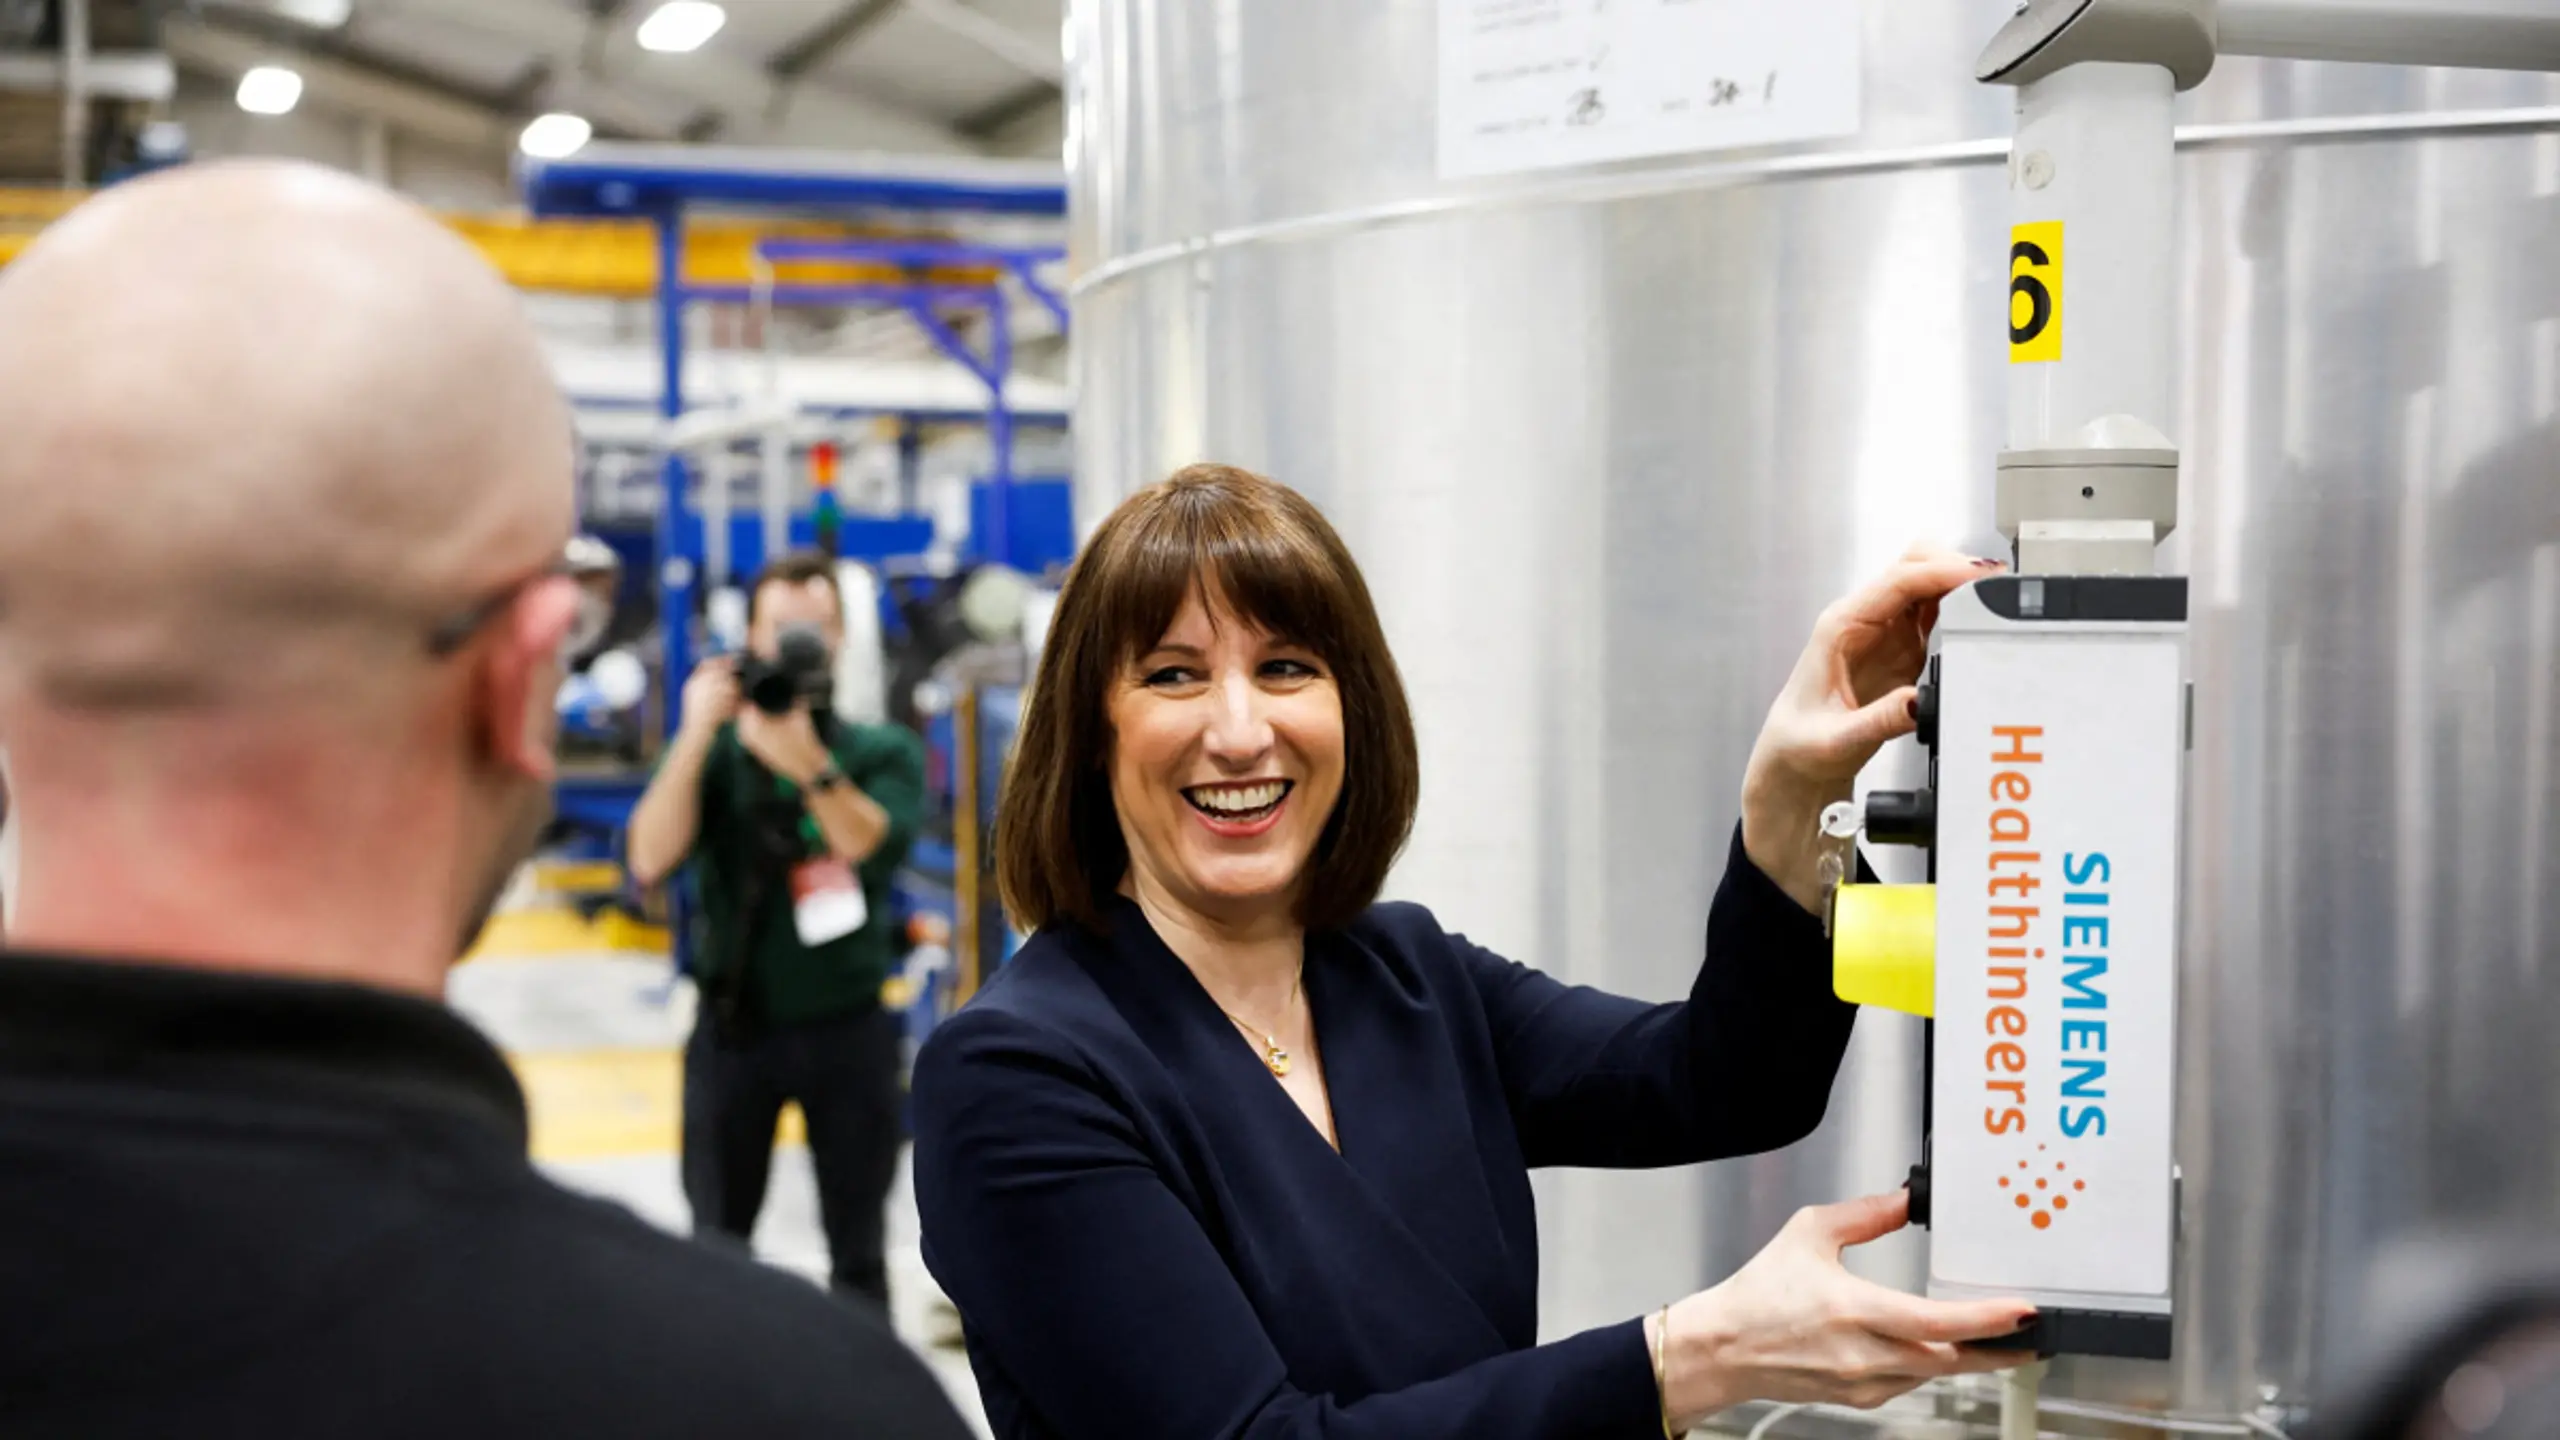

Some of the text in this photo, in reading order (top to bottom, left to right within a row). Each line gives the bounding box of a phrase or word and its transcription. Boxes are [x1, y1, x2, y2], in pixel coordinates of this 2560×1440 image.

[2009, 241, 2051, 345] 6
[1984, 725, 2045, 1135] Healthineers
[2059, 851, 2111, 1139] SIEMENS
